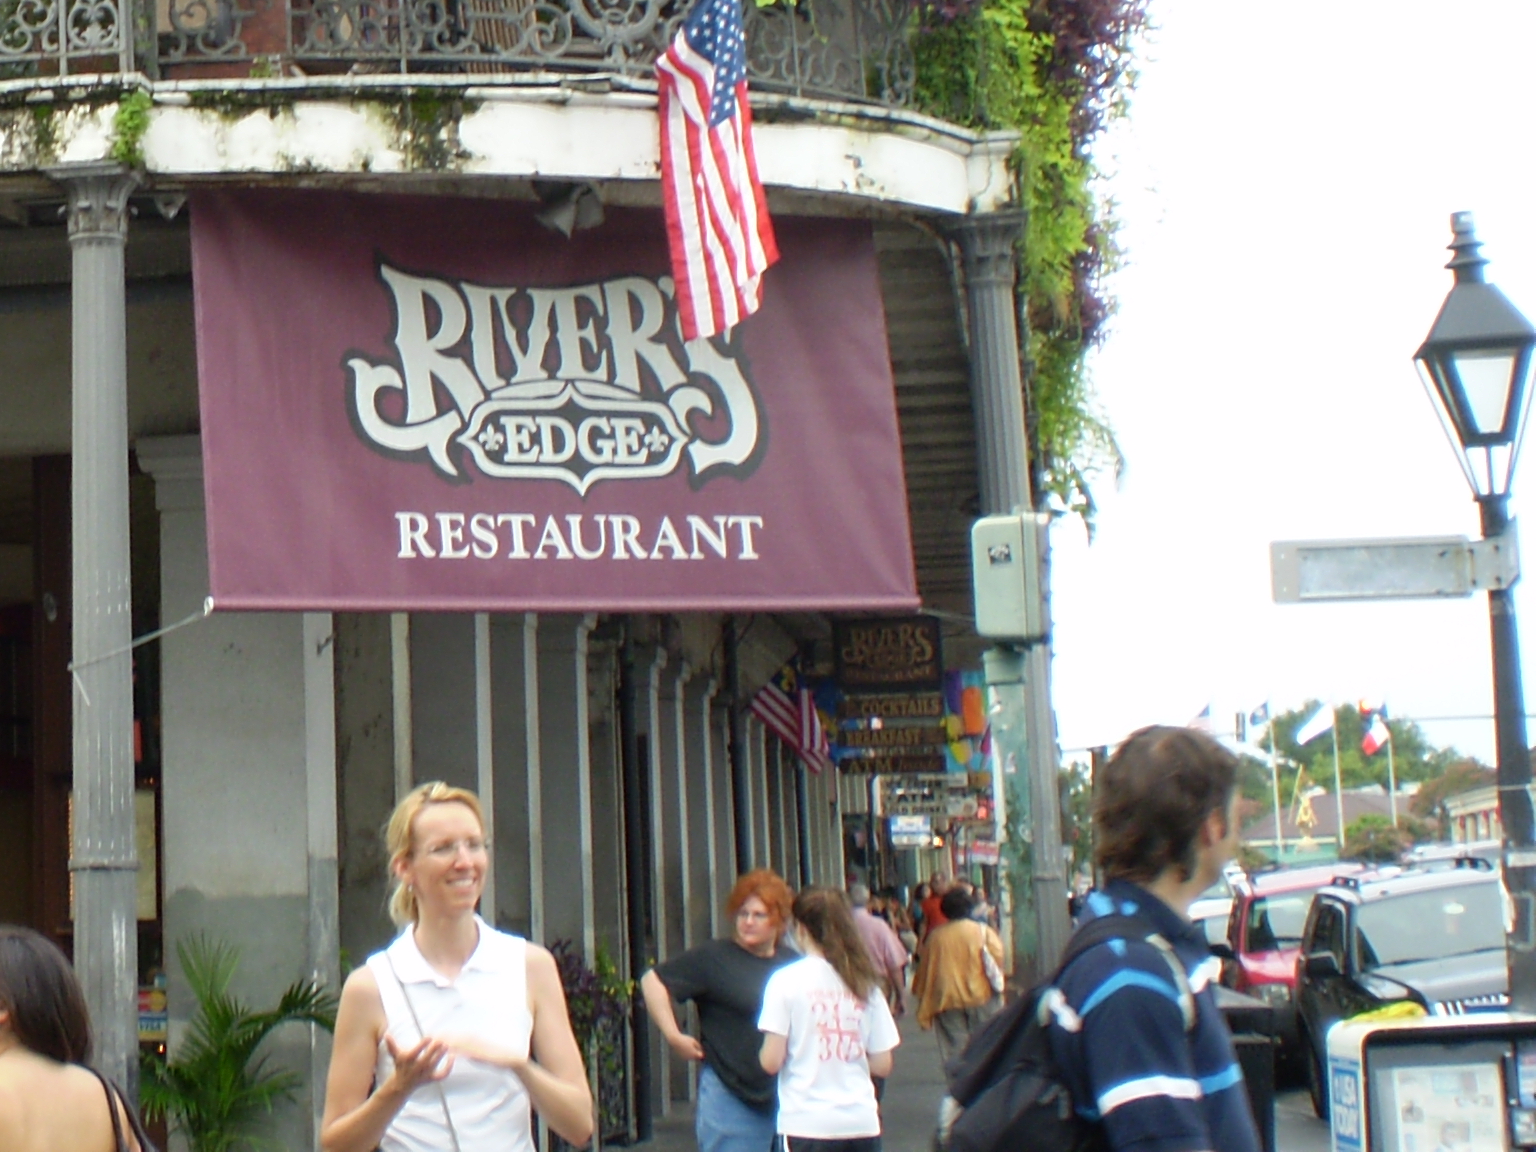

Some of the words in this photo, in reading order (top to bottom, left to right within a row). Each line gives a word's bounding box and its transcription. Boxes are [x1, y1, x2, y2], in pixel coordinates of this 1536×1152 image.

[500, 414, 650, 465] EDGE
[395, 511, 763, 561] RESTAURANT
[861, 698, 940, 717] COCKTAILS
[846, 727, 921, 746] BREAKFAST
[849, 757, 893, 773] ATM
